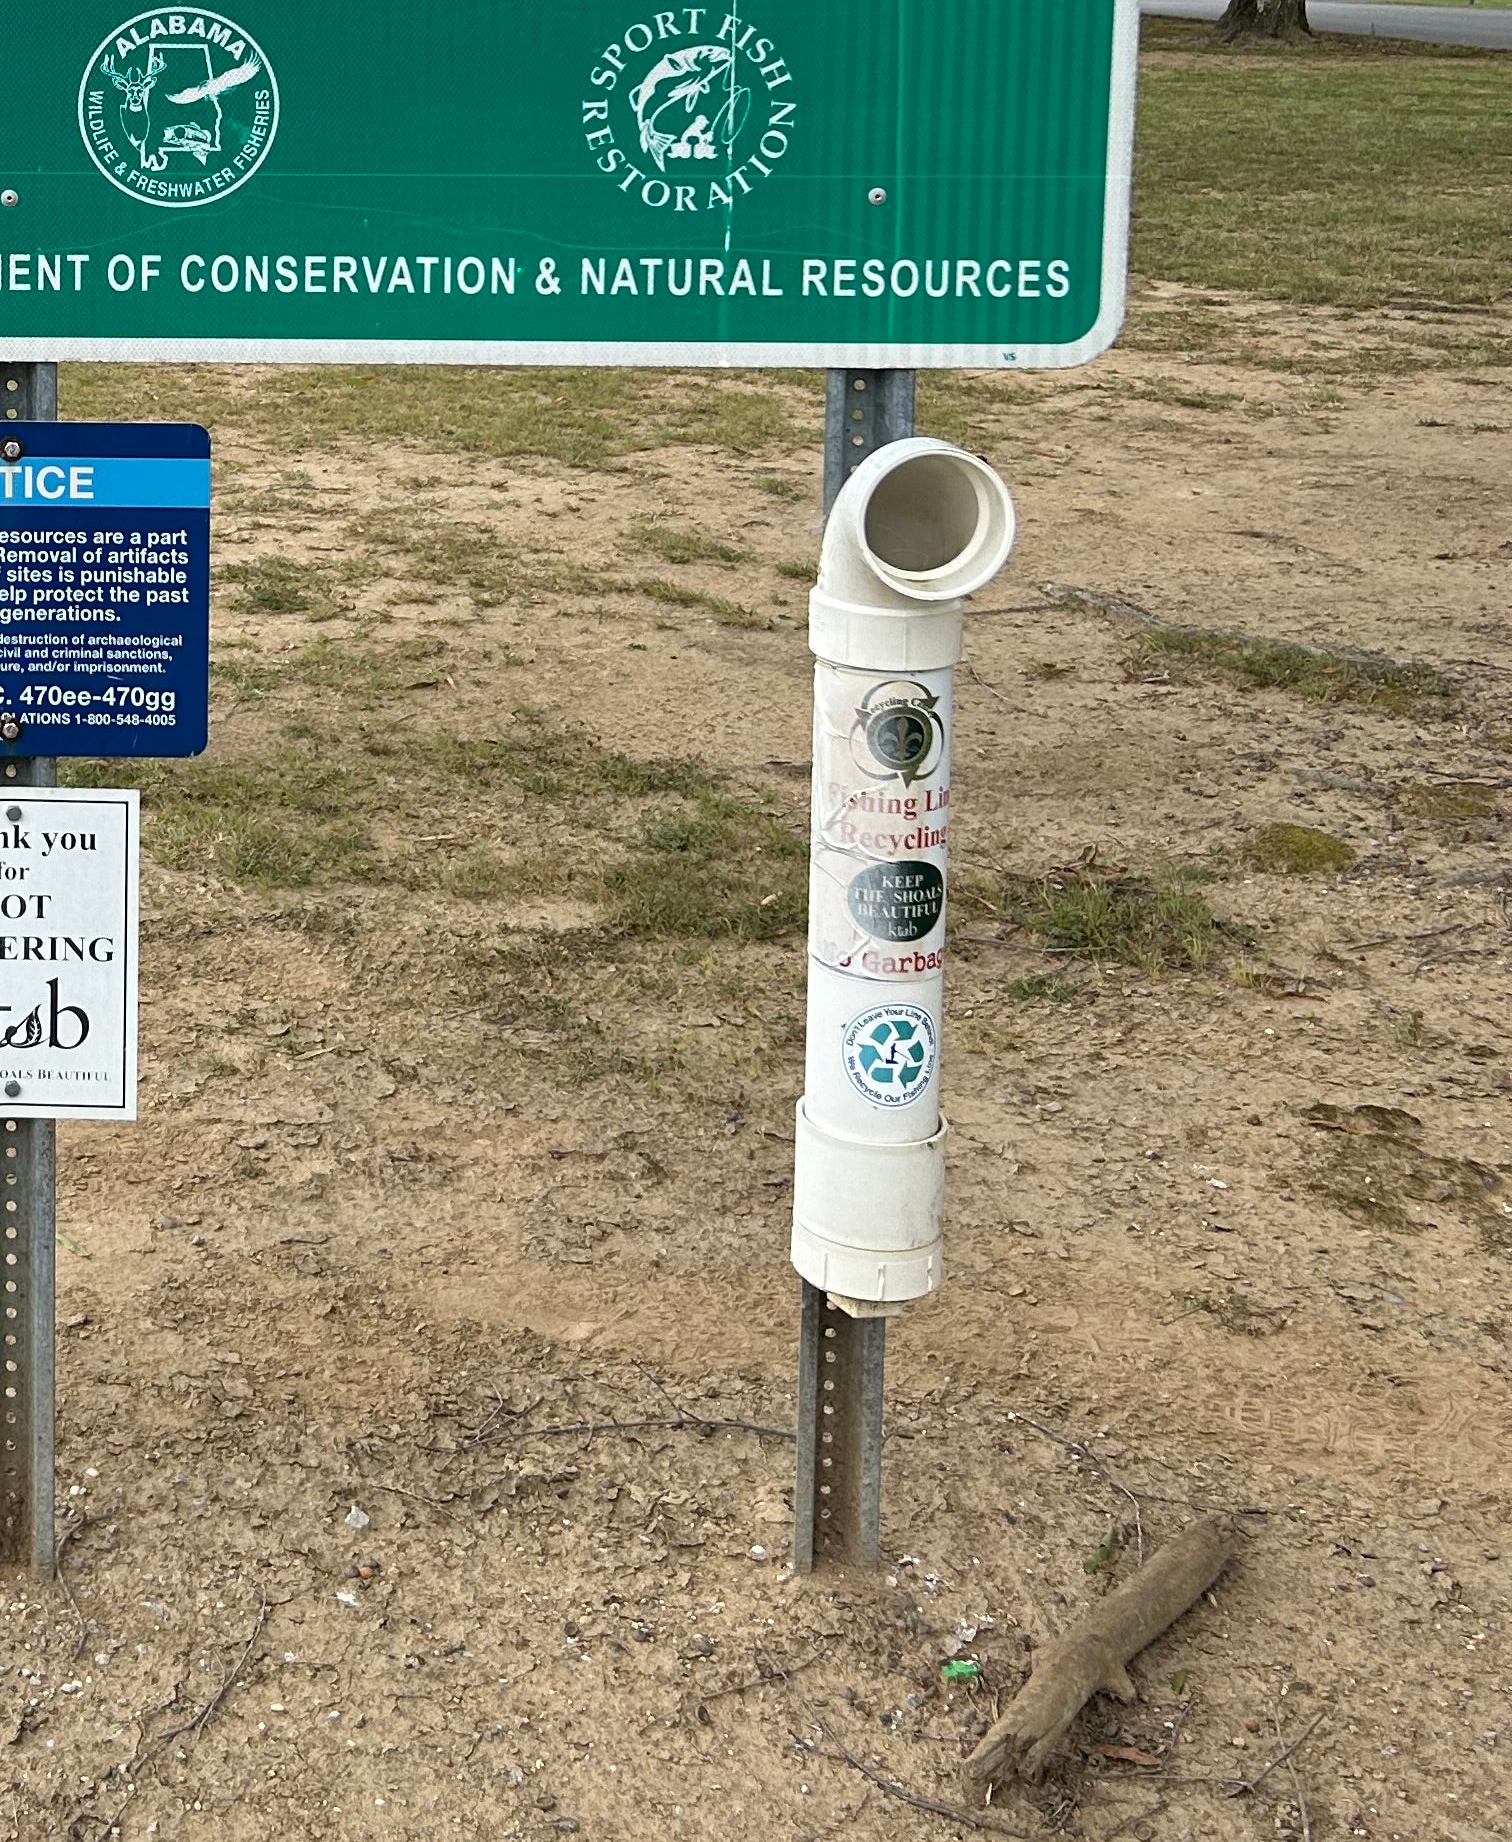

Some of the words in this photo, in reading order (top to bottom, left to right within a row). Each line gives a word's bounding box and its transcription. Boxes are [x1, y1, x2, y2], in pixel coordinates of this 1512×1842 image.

[116, 15, 247, 61] ALABAMA
[590, 8, 707, 91] SPORT
[715, 13, 793, 92] FISH
[88, 89, 120, 164] WILDLIFE
[114, 161, 128, 177] &
[126, 166, 236, 198] FRESHWATER
[232, 89, 270, 171] FISHERIES
[581, 99, 798, 212] RESTORATION
[108, 254, 161, 291] OF
[181, 254, 521, 294] CONSERVATION
[535, 257, 561, 295] &
[581, 256, 783, 296] NATURAL
[802, 259, 1069, 297] RESOURCES
[93, 532, 124, 544] are
[130, 532, 141, 544] a
[148, 530, 187, 547] part
[83, 547, 102, 563] of
[108, 546, 188, 564] artifacts
[7, 566, 52, 582] sites
[59, 566, 74, 582] is
[81, 567, 187, 585] punishable
[33, 585, 104, 605] protect
[109, 586, 140, 602] the
[146, 587, 189, 605] past
[0, 605, 121, 624] generations.
[72, 634, 85, 648] of
[88, 634, 182, 648] archaeological
[24, 647, 48, 658] and
[52, 647, 103, 659] criminal
[107, 647, 172, 661] sanctions,
[28, 661, 71, 672] and/or
[74, 661, 166, 674] imprisonment.
[19, 686, 175, 711] 470ee-470gg
[75, 713, 176, 726] 1-800-548-4005
[41, 833, 96, 856] you
[882, 874, 924, 889] KEEP
[854, 886, 886, 902] THE
[893, 884, 943, 904] SHOALS
[857, 902, 938, 919] BEAUTIFUL
